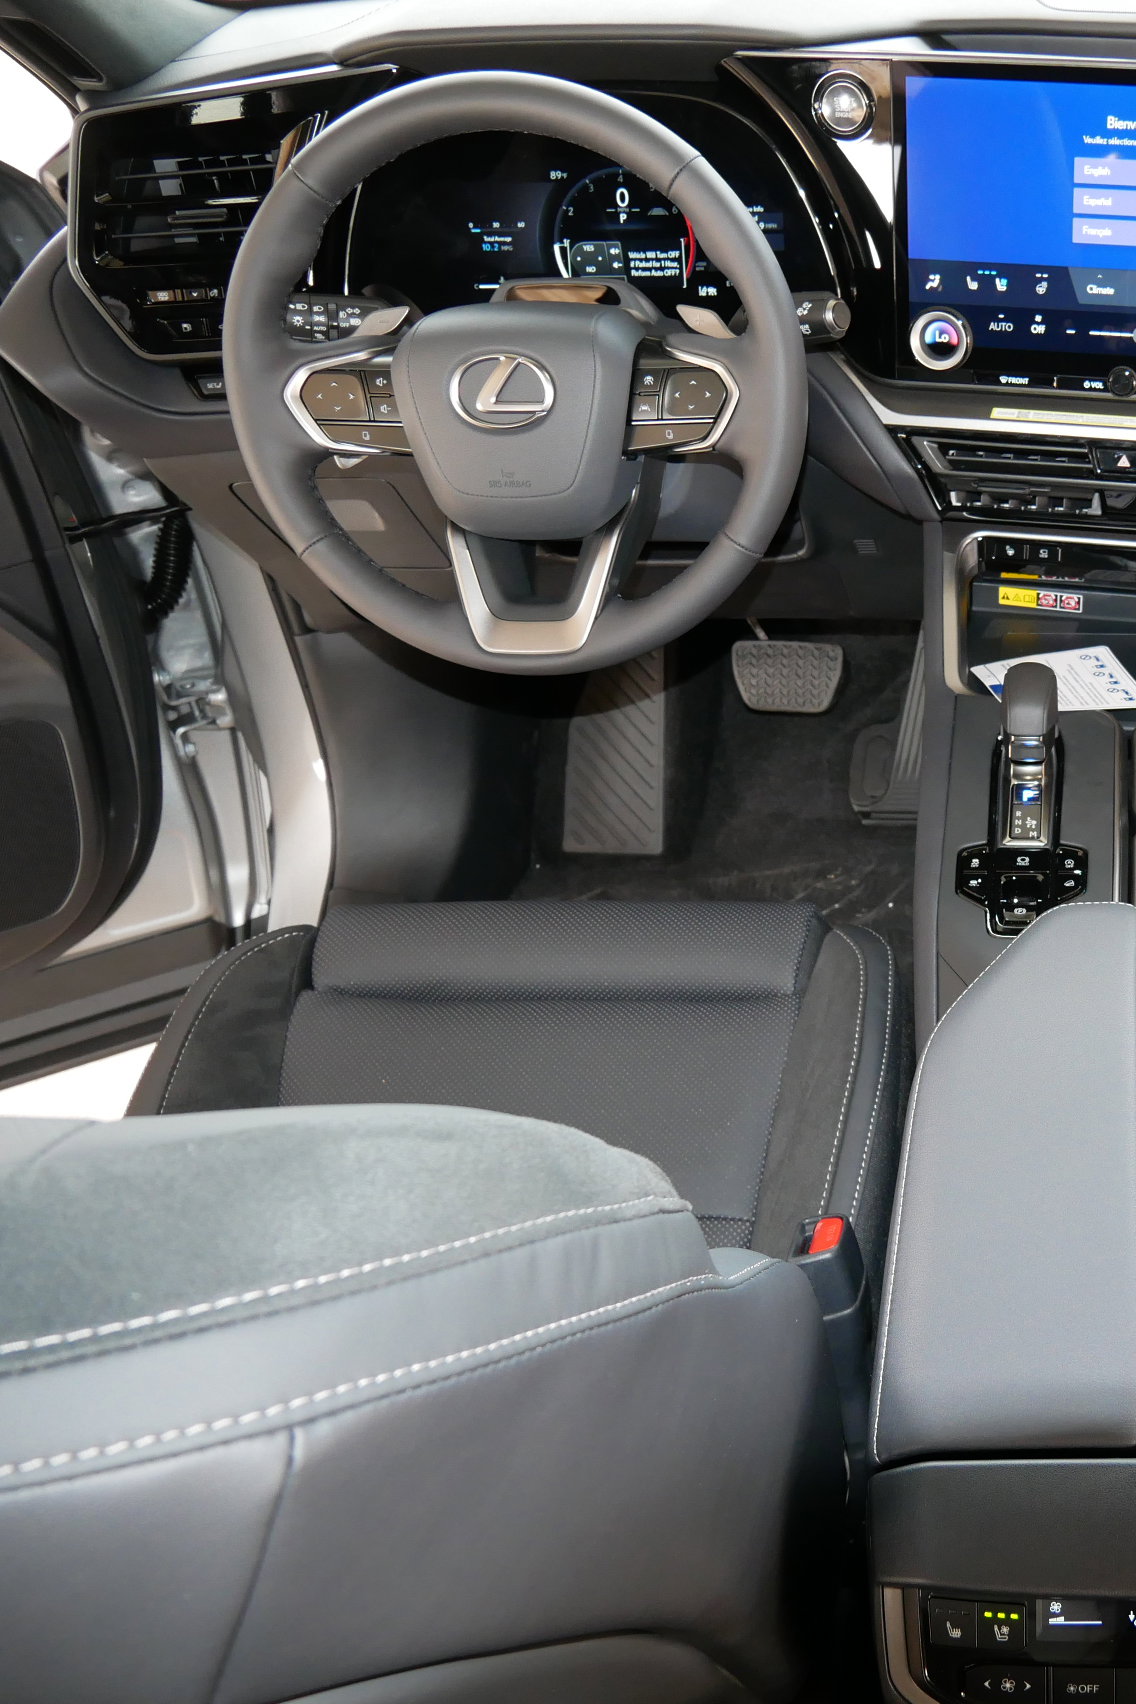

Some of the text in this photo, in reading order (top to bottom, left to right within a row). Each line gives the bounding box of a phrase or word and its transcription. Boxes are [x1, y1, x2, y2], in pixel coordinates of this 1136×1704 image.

[1083, 135, 1107, 145] Veuillez
[1083, 165, 1111, 177] English
[617, 174, 623, 182] 4
[588, 184, 594, 193] 3
[615, 187, 629, 208] 0
[568, 207, 574, 216] 2
[620, 213, 627, 224] P
[482, 243, 499, 251] 10.2
[635, 260, 653, 268] Parked
[653, 260, 661, 268] for
[631, 269, 651, 277] Perform
[1086, 284, 1116, 296] Climate
[988, 322, 1014, 332] AUTO
[1030, 324, 1046, 335] Off
[935, 330, 950, 343] Lo
[1008, 376, 1030, 385] FRONT
[1090, 380, 1104, 389] VOL
[488, 480, 532, 488] SRS AIRBAG
[1022, 789, 1033, 802] P
[1078, 1683, 1099, 1694] OFF
